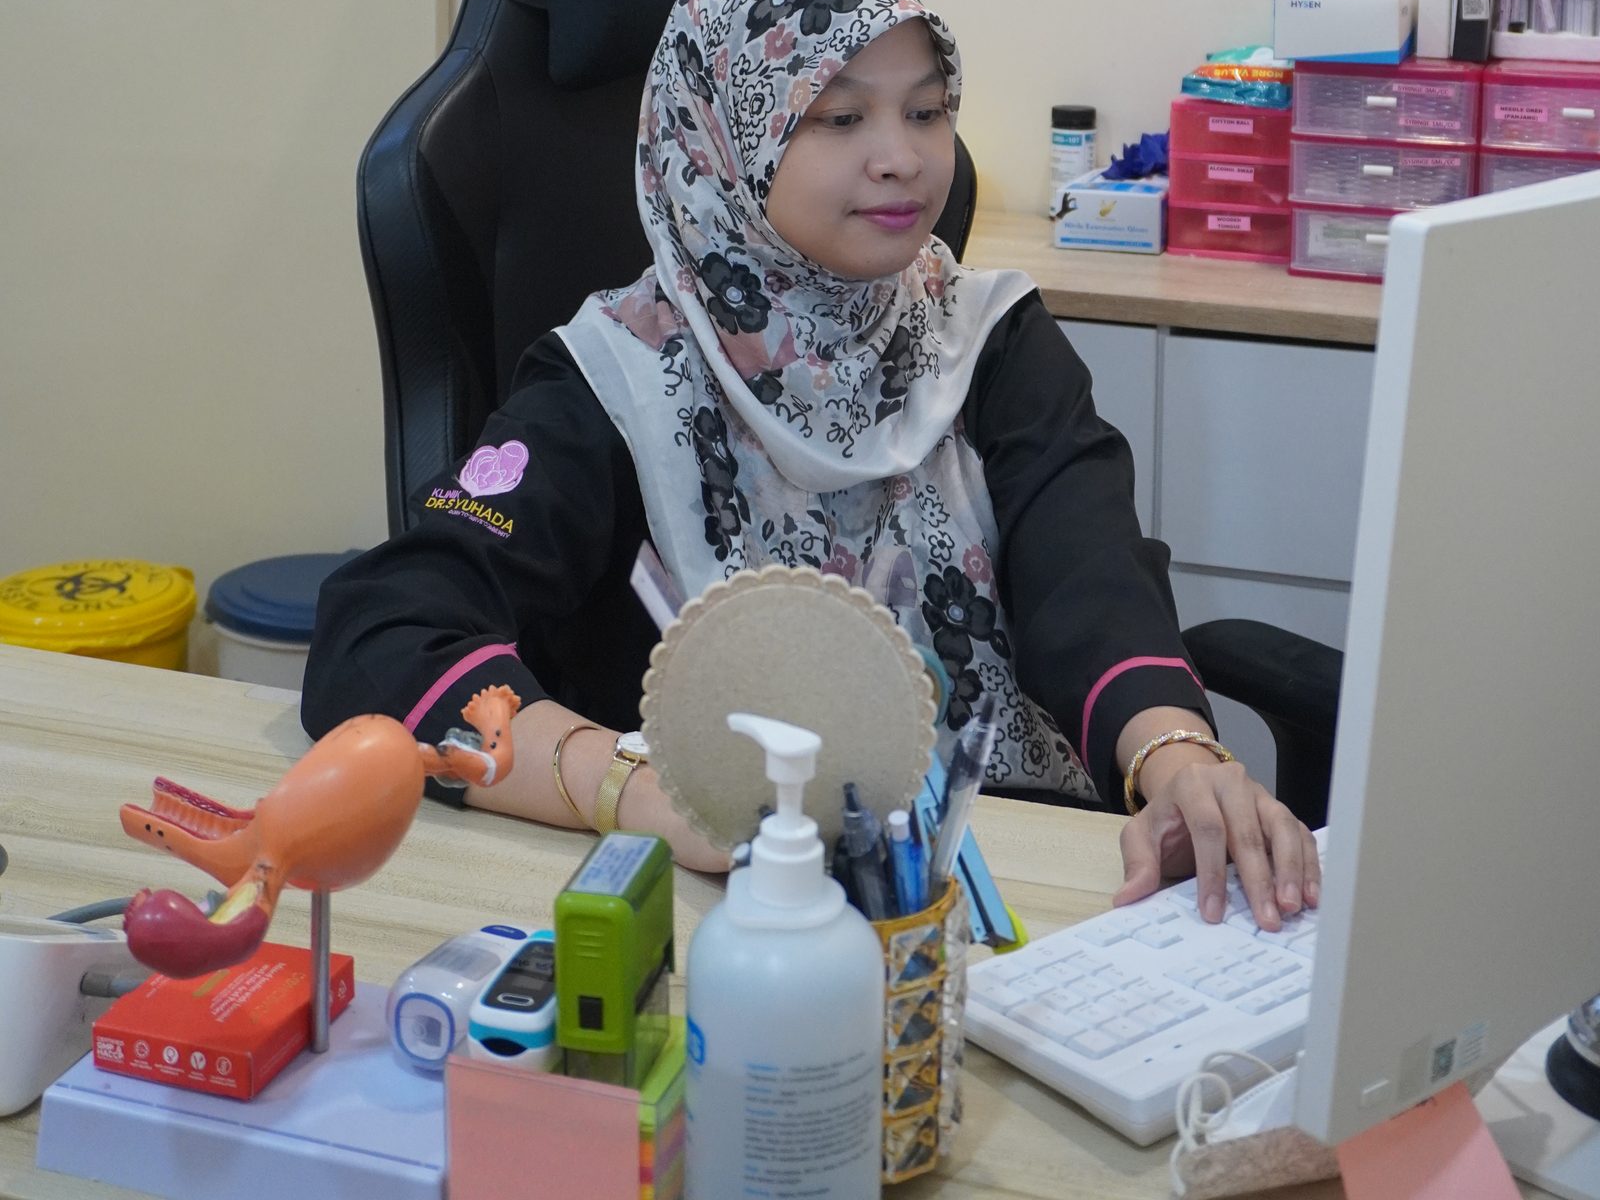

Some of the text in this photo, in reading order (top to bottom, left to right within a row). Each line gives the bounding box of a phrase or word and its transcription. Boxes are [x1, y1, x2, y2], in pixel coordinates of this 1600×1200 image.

[1290, 0, 1321, 9] HYSEN
[1252, 68, 1284, 79] MORE
[431, 487, 463, 499] KLINIK
[425, 497, 514, 534] DR.SYUHADA
